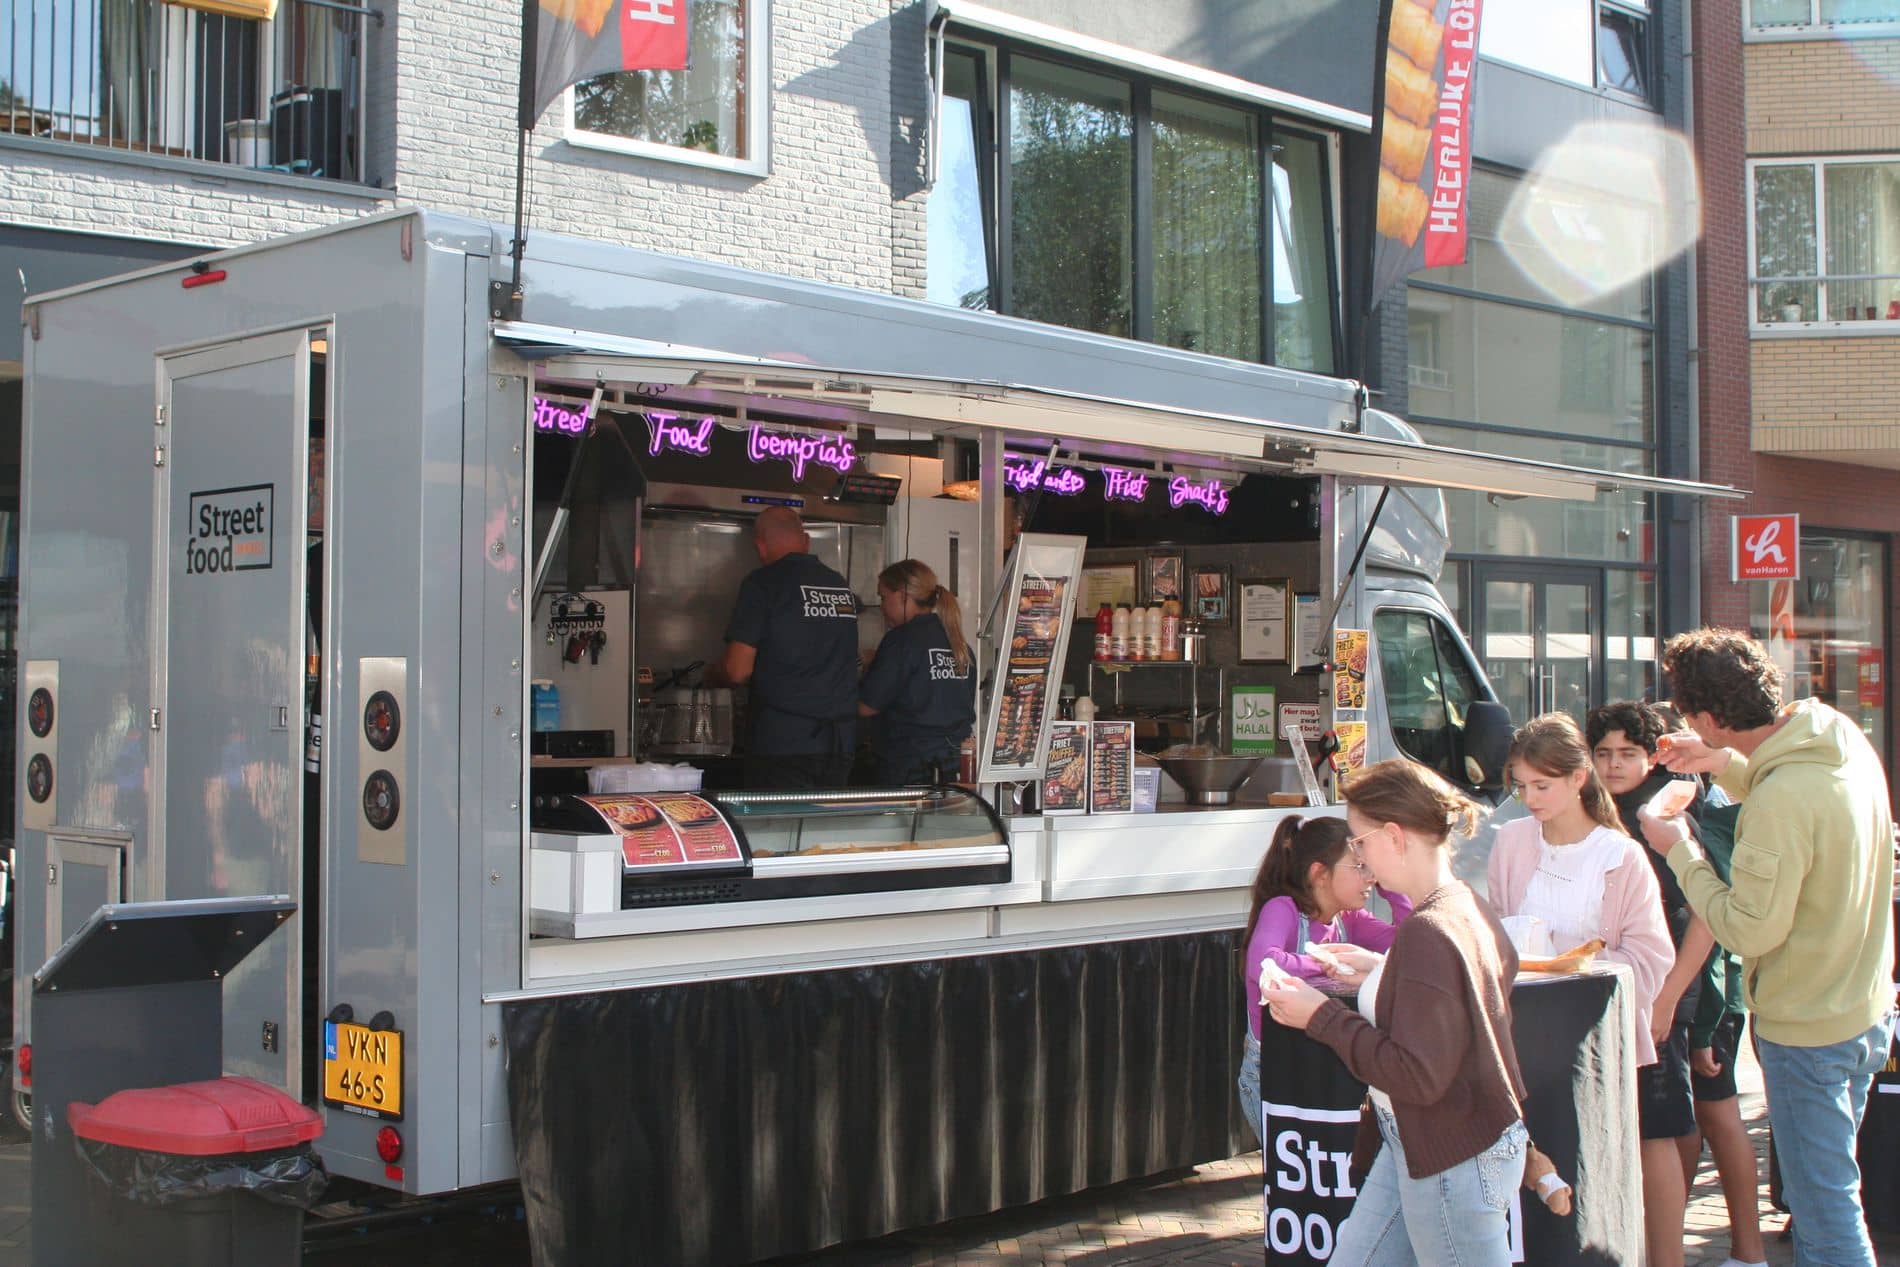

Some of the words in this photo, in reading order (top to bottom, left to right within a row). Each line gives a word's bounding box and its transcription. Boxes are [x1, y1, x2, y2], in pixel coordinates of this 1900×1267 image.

[650, 412, 714, 453] Food
[199, 501, 264, 538] Street
[186, 535, 233, 574] food
[1745, 566, 1789, 574] vanHaren
[804, 602, 837, 617] food
[810, 590, 851, 606] Street
[936, 652, 956, 667] Stre
[930, 666, 954, 680] food
[1236, 723, 1271, 735] HALAL
[347, 1028, 388, 1066] VKN
[340, 1068, 386, 1105] 46-S
[1275, 1130, 1357, 1198] Str
